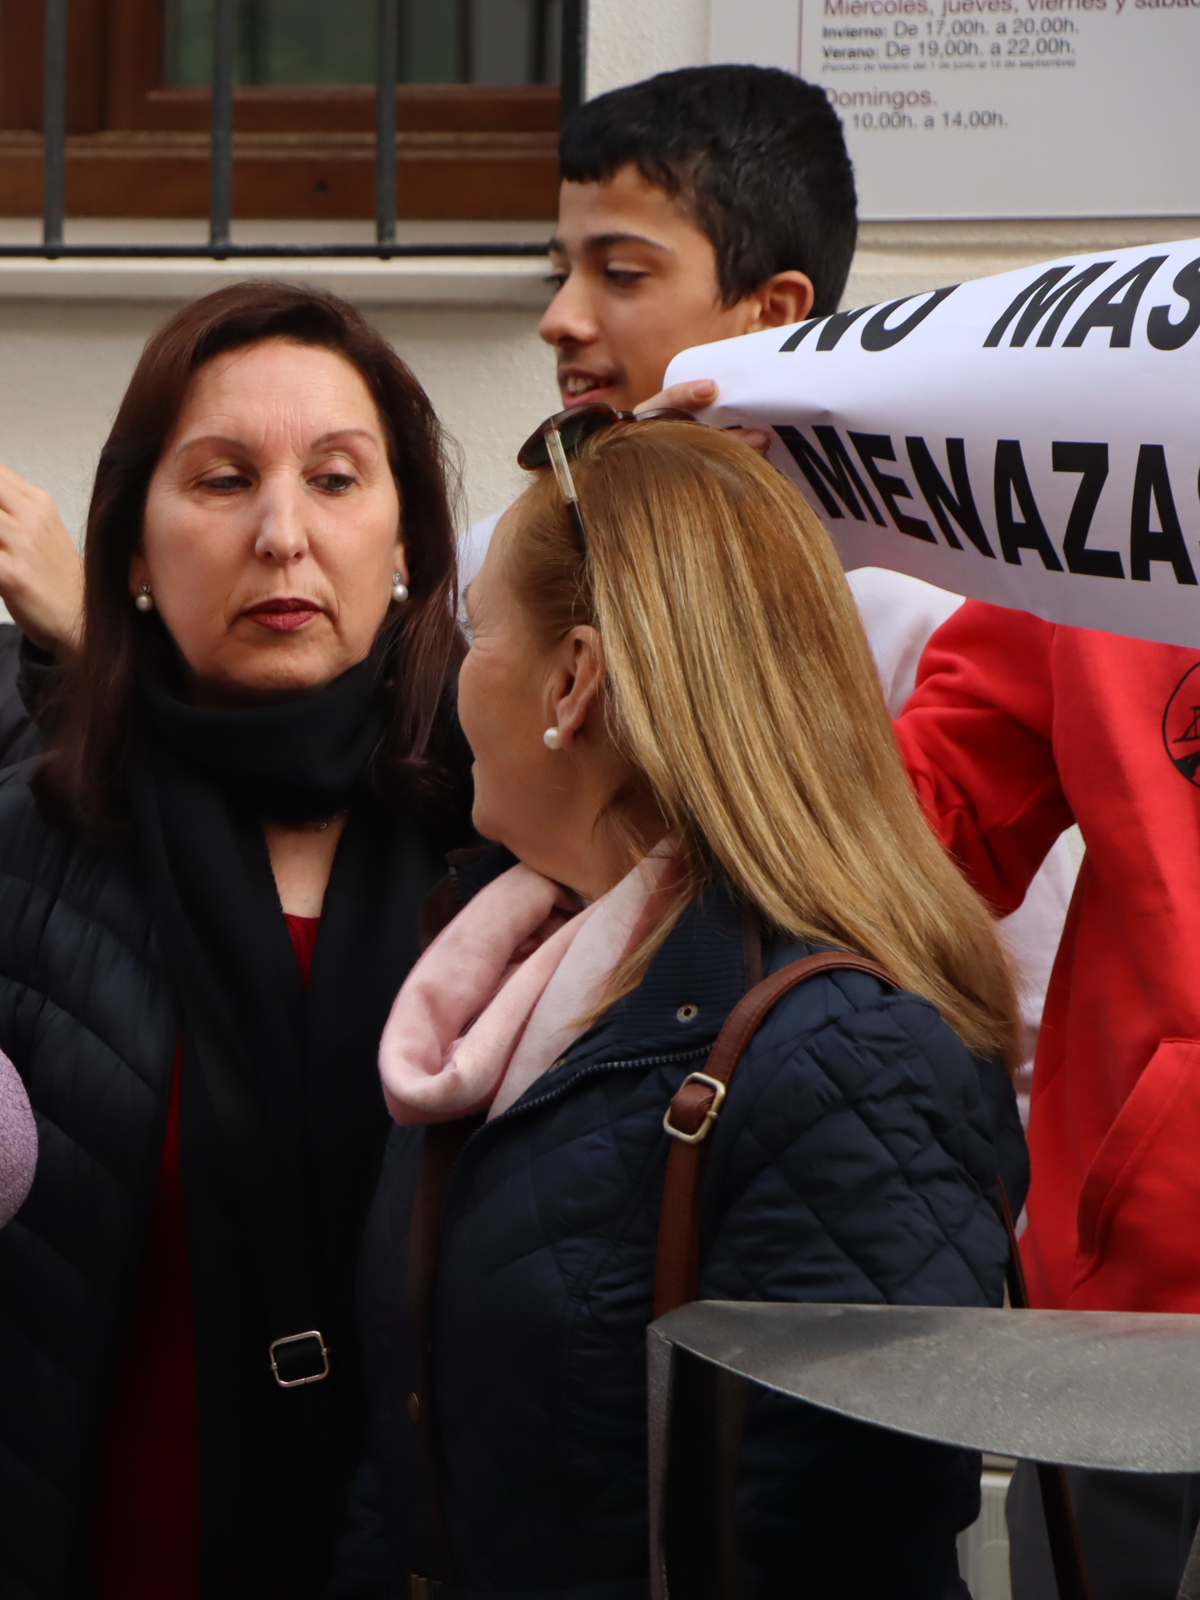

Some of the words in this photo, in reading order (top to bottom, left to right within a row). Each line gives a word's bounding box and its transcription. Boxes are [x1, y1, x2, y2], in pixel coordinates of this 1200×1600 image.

[941, 0, 1018, 17] jueves,
[1115, 0, 1127, 15] y
[822, 25, 887, 39] Invierno:
[894, 20, 919, 37] De
[926, 19, 989, 37] 17,00h.
[996, 21, 1007, 35] a
[1012, 17, 1079, 35] 20,00h.
[822, 45, 879, 59] Verano:
[886, 40, 911, 57] De
[918, 39, 983, 57] 19,00h.
[990, 41, 1001, 55] a
[1007, 37, 1076, 56] 22,00h.
[825, 87, 937, 110] Domingos.
[853, 112, 918, 130] 10,00h.
[924, 115, 935, 128] a
[942, 110, 1008, 128] 14,00h.
[982, 254, 1200, 351] MAS
[719, 424, 1200, 586] MENAZA
